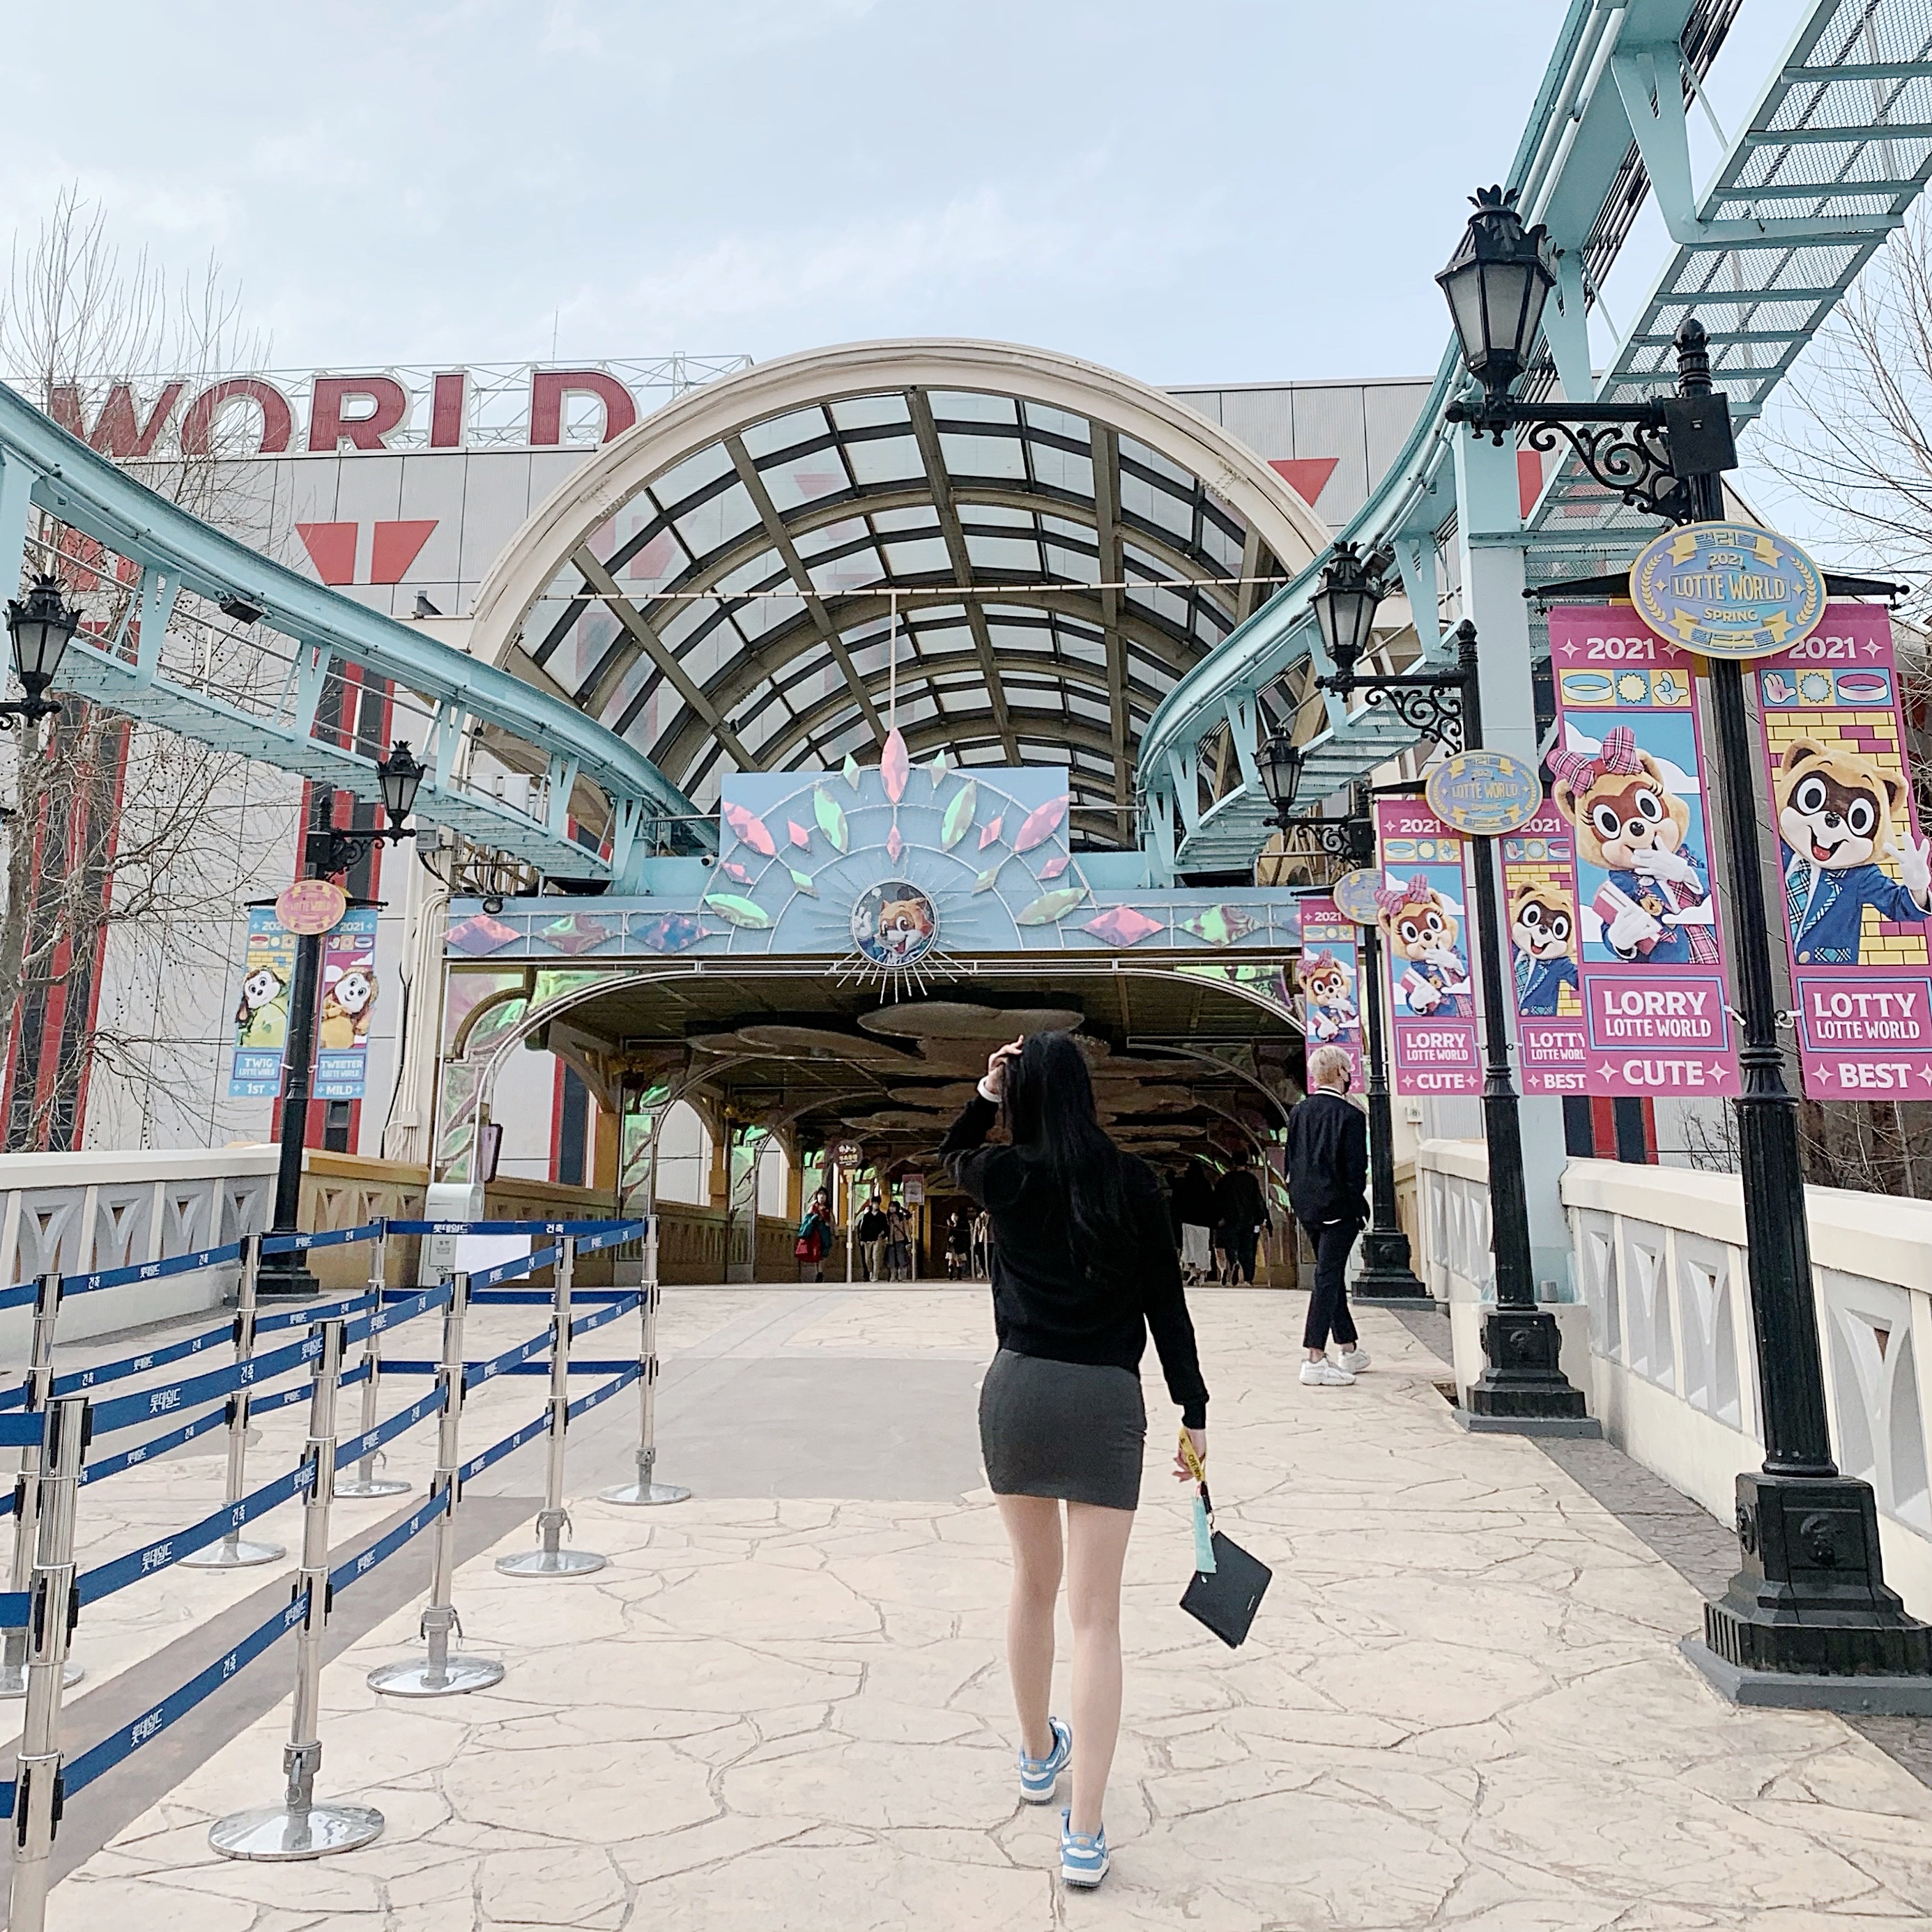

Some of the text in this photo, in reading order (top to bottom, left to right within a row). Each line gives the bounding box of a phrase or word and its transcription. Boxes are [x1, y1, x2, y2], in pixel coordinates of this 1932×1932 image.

[1708, 553, 1743, 567] 2021
[1675, 574, 1785, 601] LOTTE WORLD
[1703, 608, 1758, 622] SPRING
[1587, 637, 1656, 659] 2021
[1788, 636, 1857, 659] 2021
[1400, 819, 1441, 833] 2021
[1314, 912, 1342, 921] 2021
[261, 921, 286, 931] 202
[339, 921, 364, 932] 2021
[1604, 990, 1707, 1016] LORRY
[1814, 992, 1917, 1018] LOTTY
[1606, 1018, 1712, 1038] LOTTE WORLD
[1816, 1020, 1921, 1040] LOTTE WORLD
[1406, 1032, 1466, 1048] LORRY
[1406, 1049, 1469, 1061] LOTTE WORLD
[1531, 1048, 1586, 1060] LOTTE WORL
[245, 1058, 273, 1068] TWIG
[321, 1060, 363, 1069] TWEETER
[1623, 1059, 1705, 1087] CUTE
[1838, 1063, 1912, 1089] BEST
[1417, 1073, 1464, 1089] CUTE
[1544, 1074, 1586, 1089] BEST
[247, 1084, 265, 1094] 1ST
[326, 1085, 353, 1095] MILD
[433, 1223, 564, 1234] 롯데월드 건축
[89, 1275, 100, 1289] 건축
[82, 1372, 95, 1386] 건축
[149, 1336, 323, 1413] 롯데월드 건축 롯데월드
[141, 1464, 315, 1573] 롯데월드 건축 롯데월드
[130, 1708, 164, 1747] 롯데월드
[223, 1653, 238, 1678] 건축
